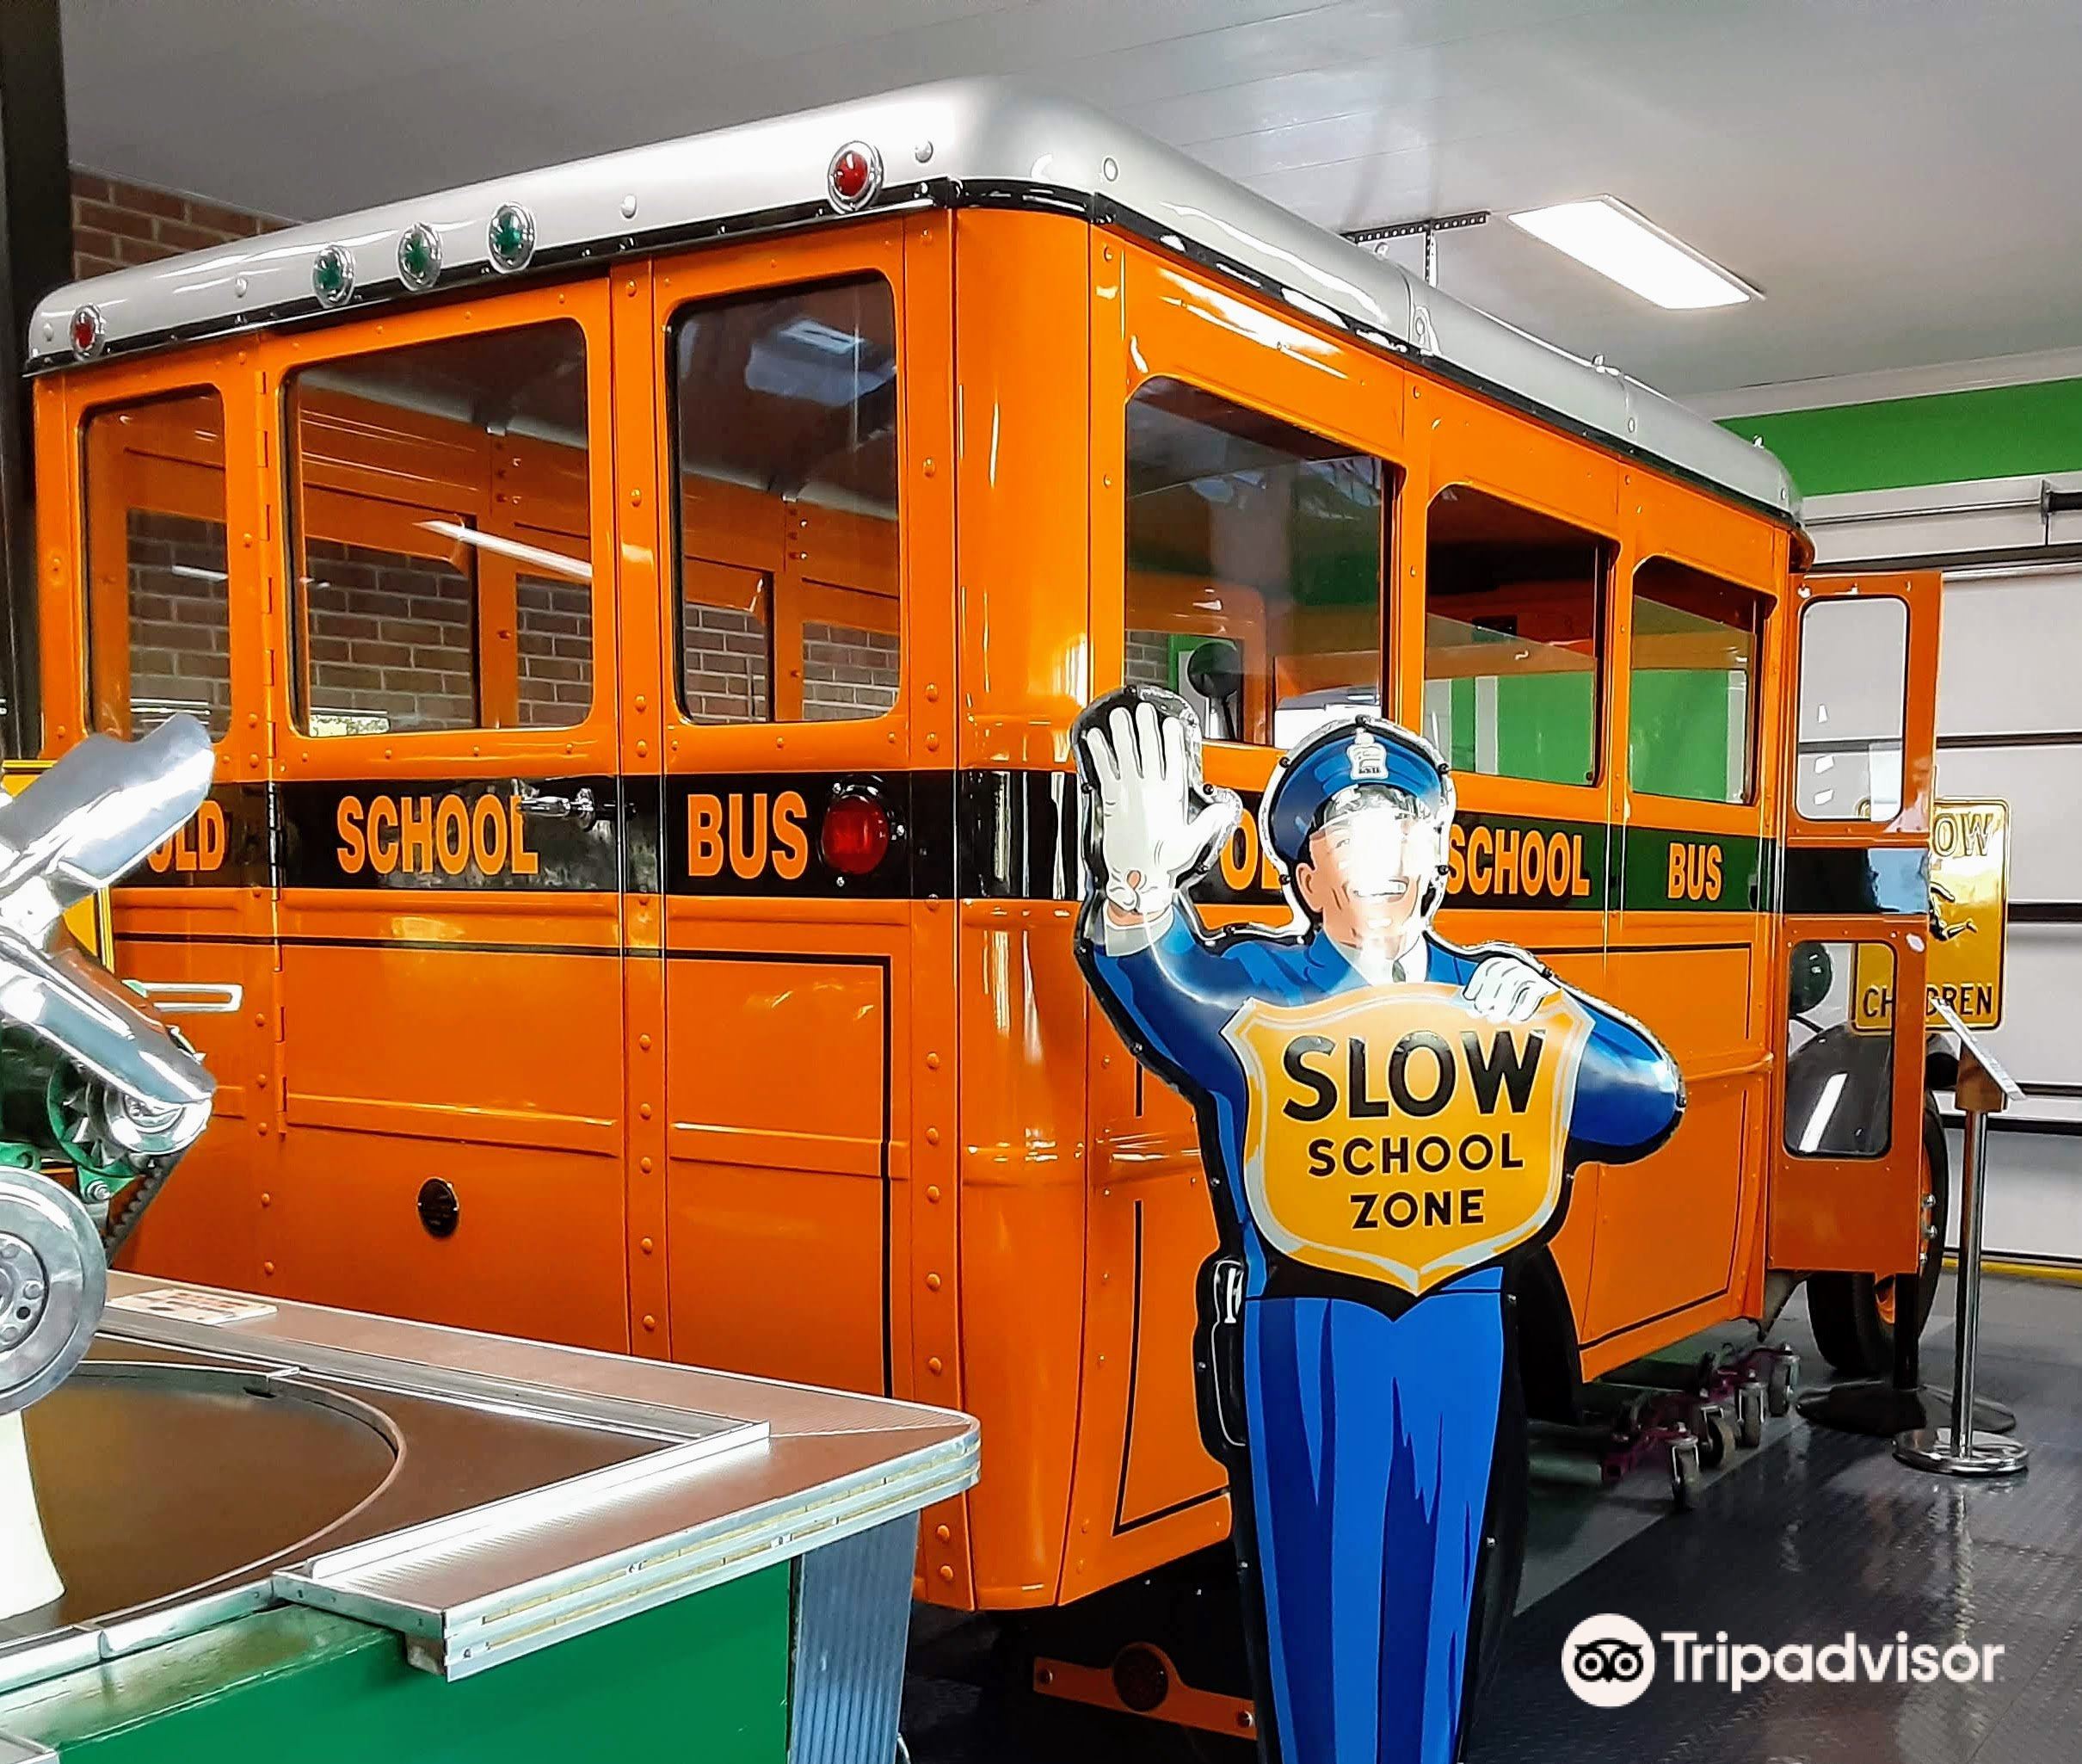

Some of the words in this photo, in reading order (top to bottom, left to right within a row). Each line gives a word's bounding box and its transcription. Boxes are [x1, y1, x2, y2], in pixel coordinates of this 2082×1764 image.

[336, 793, 539, 875] SCHOOL
[687, 791, 809, 879] BUS
[1932, 812, 1993, 857] OW
[1445, 823, 1590, 897] SCHOOL
[1667, 842, 1722, 901] BUS
[1863, 984, 1993, 1018] CHDREN
[1282, 1029, 1546, 1122] SLOW
[1308, 1132, 1524, 1177] SCHOOL
[1350, 1189, 1485, 1230] ZONE
